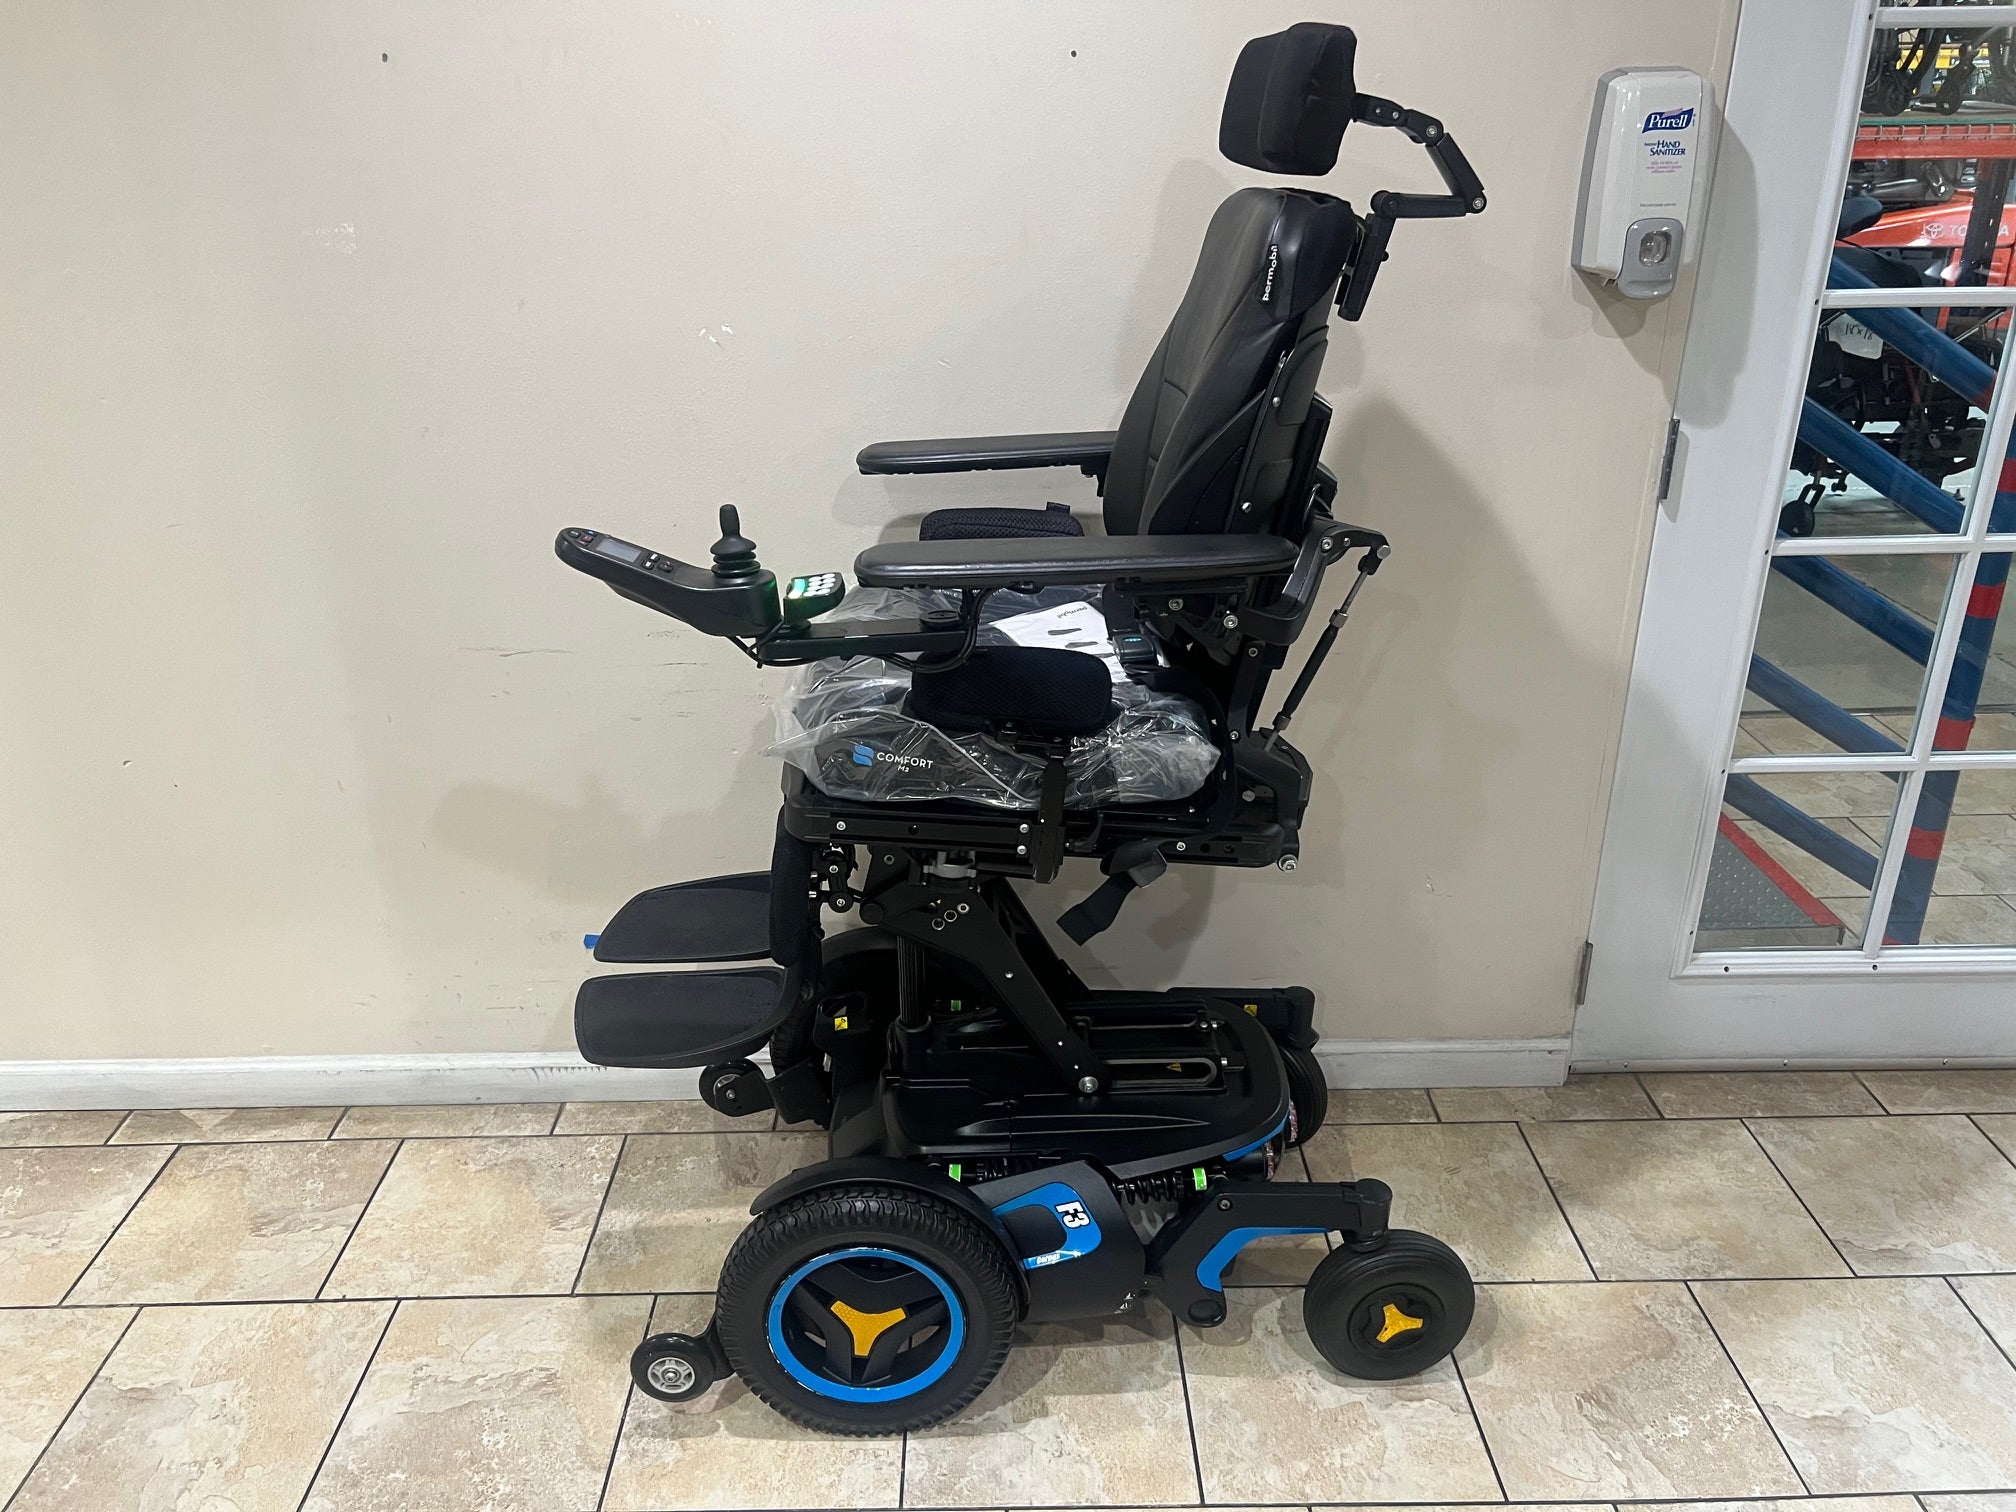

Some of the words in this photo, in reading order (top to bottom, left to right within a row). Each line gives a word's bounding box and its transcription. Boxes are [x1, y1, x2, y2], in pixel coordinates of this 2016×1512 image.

[1648, 114, 1688, 128] Purell
[1657, 140, 1681, 148] HAND
[1650, 147, 1686, 156] SANITIZER
[1949, 225, 2009, 236] TOA
[876, 752, 934, 769] COMFORT
[1055, 1201, 1090, 1229] F3
